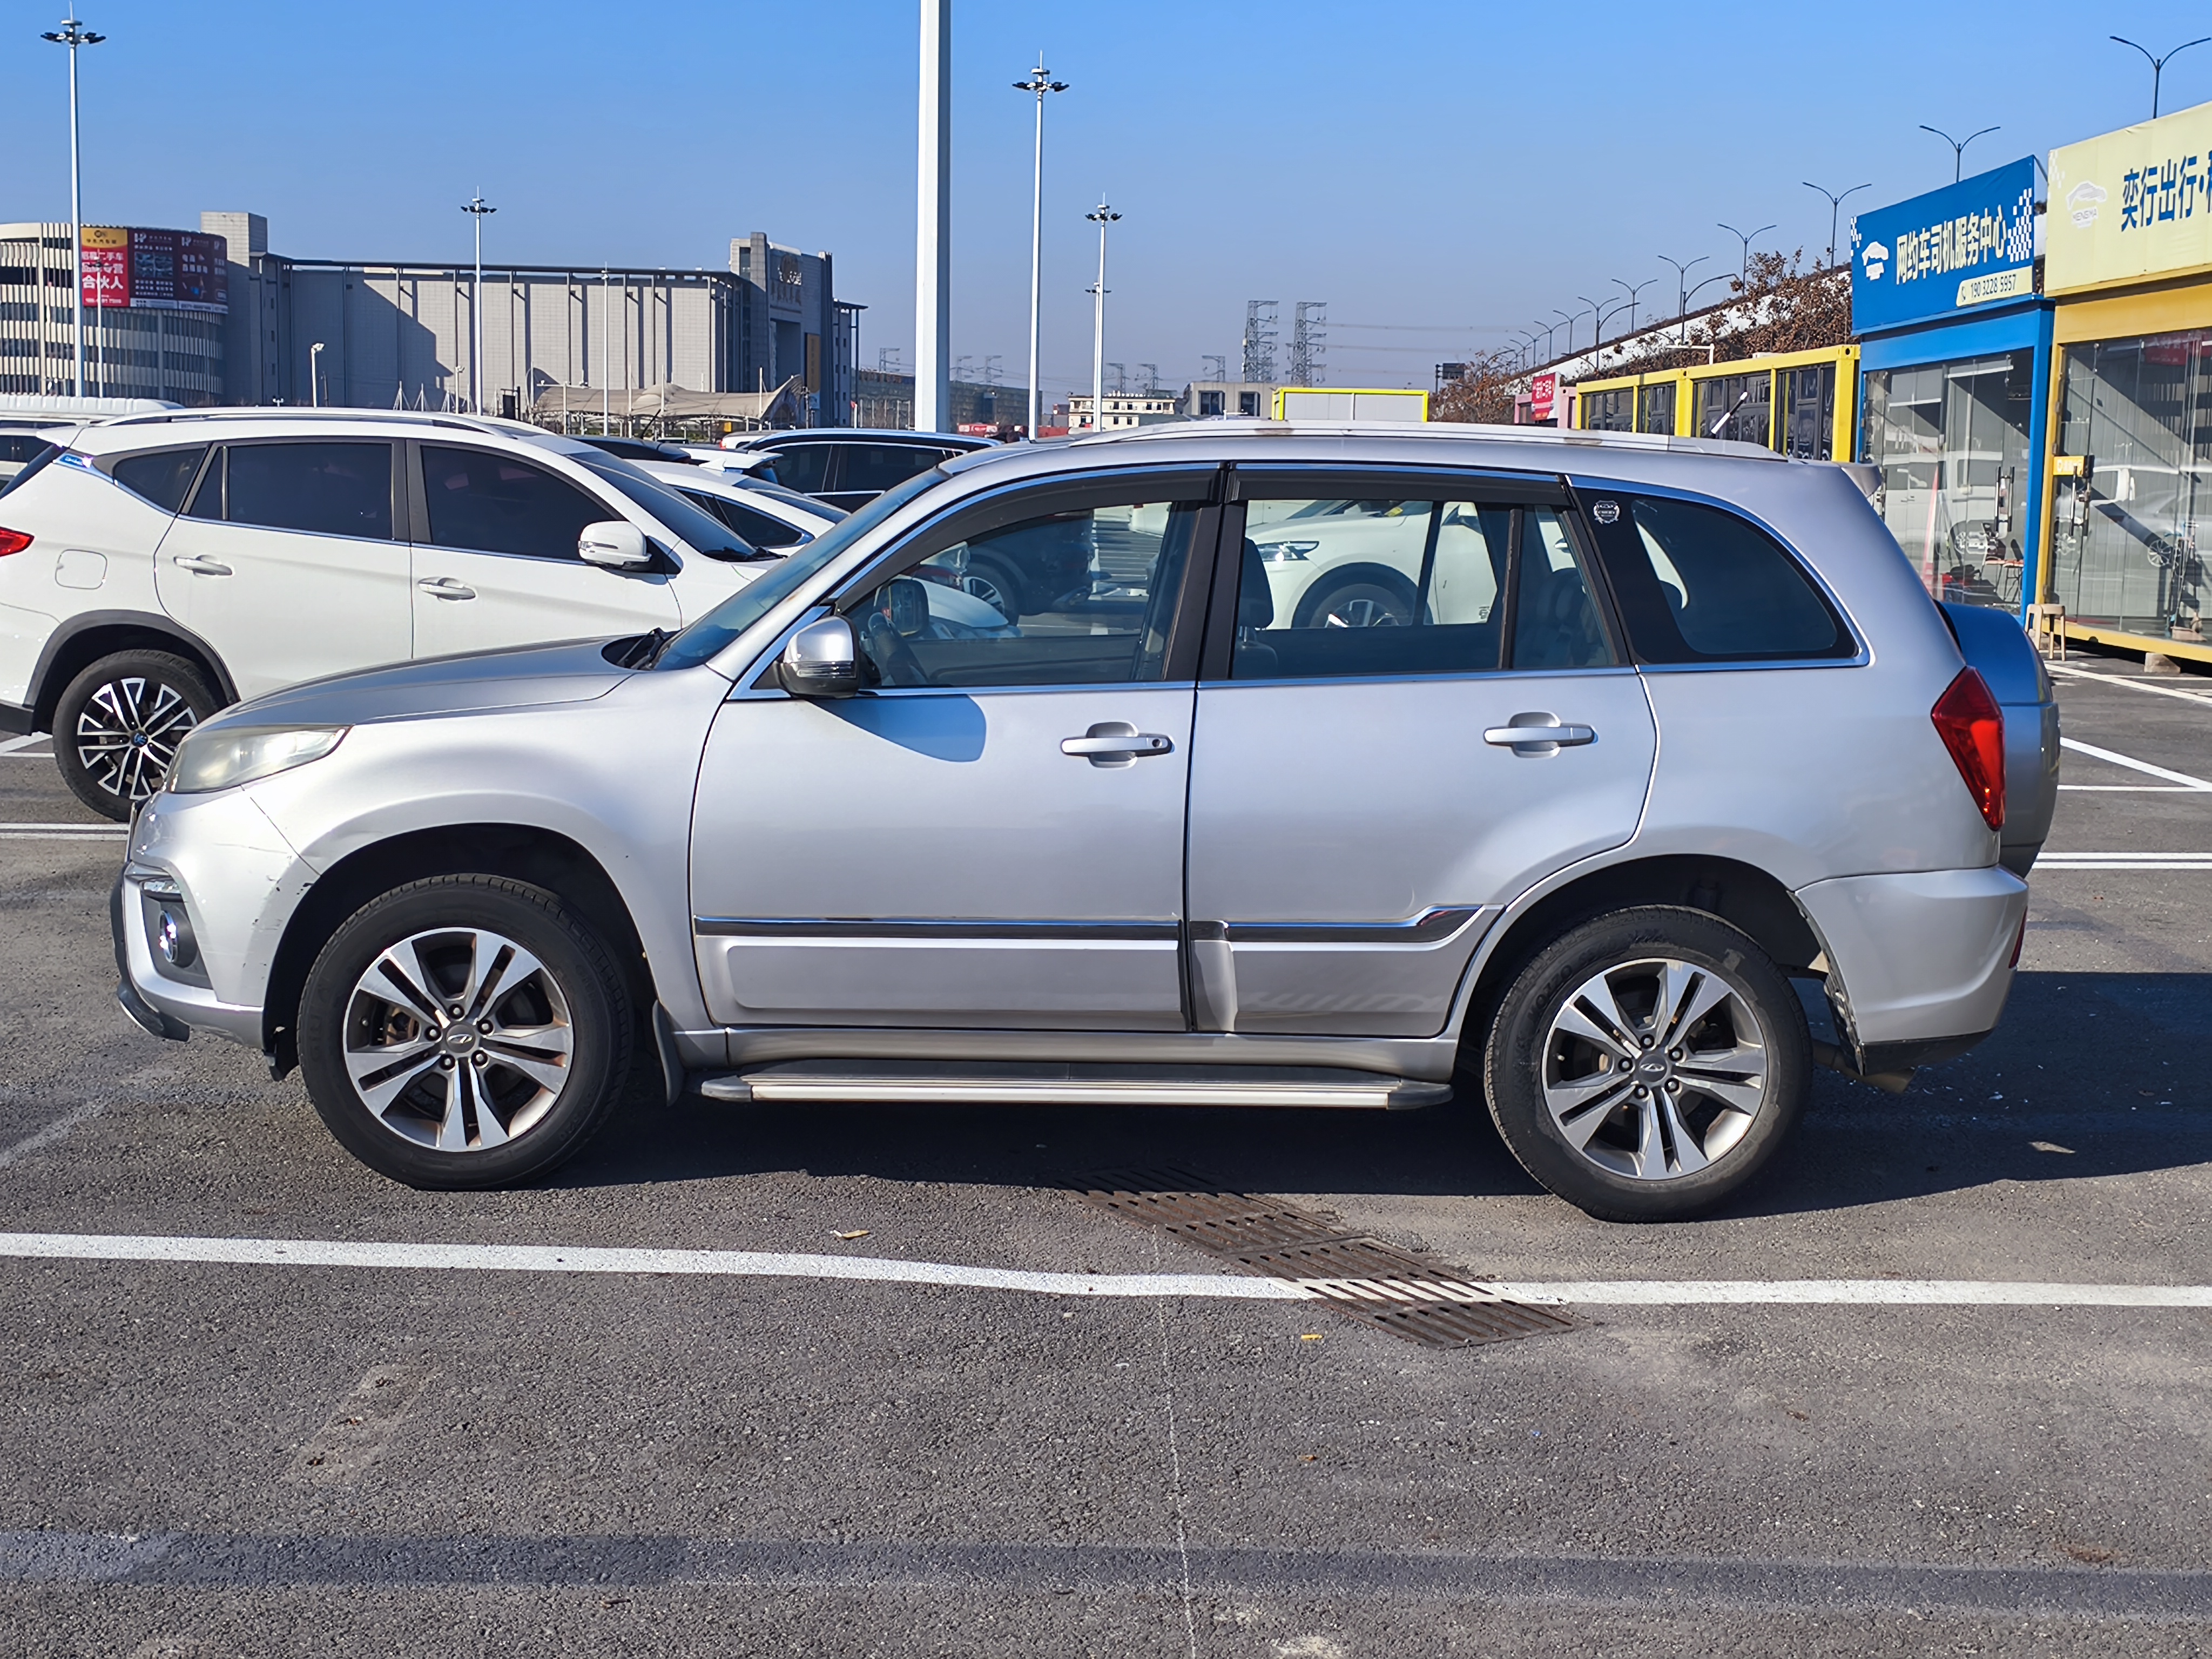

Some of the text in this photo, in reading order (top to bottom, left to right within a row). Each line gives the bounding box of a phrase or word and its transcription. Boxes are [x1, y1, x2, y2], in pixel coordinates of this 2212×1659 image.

[2121, 150, 2212, 232] 奕行出行·
[1896, 204, 2007, 285] 网约车司机服务中心
[82, 274, 124, 289] 合伙人
[1971, 274, 2016, 298] 190 3228 5957
